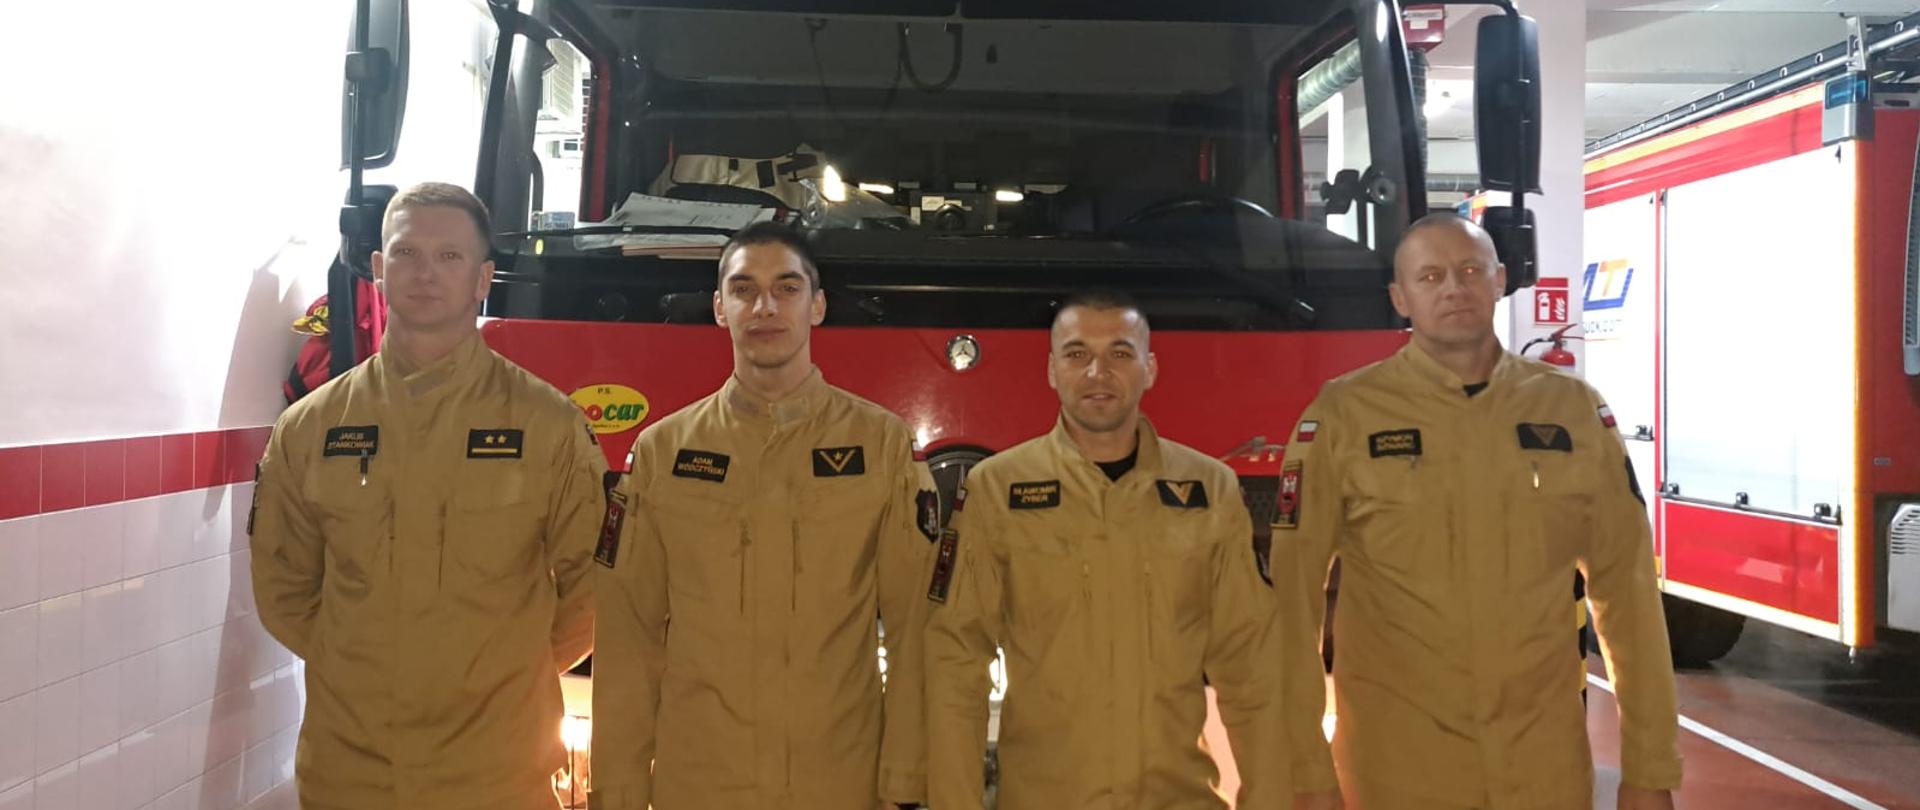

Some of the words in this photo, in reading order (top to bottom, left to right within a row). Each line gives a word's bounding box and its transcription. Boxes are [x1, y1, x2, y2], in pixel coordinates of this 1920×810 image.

[584, 403, 645, 421] ocar
[339, 431, 364, 440] JAKUB
[692, 455, 713, 466] ADAM
